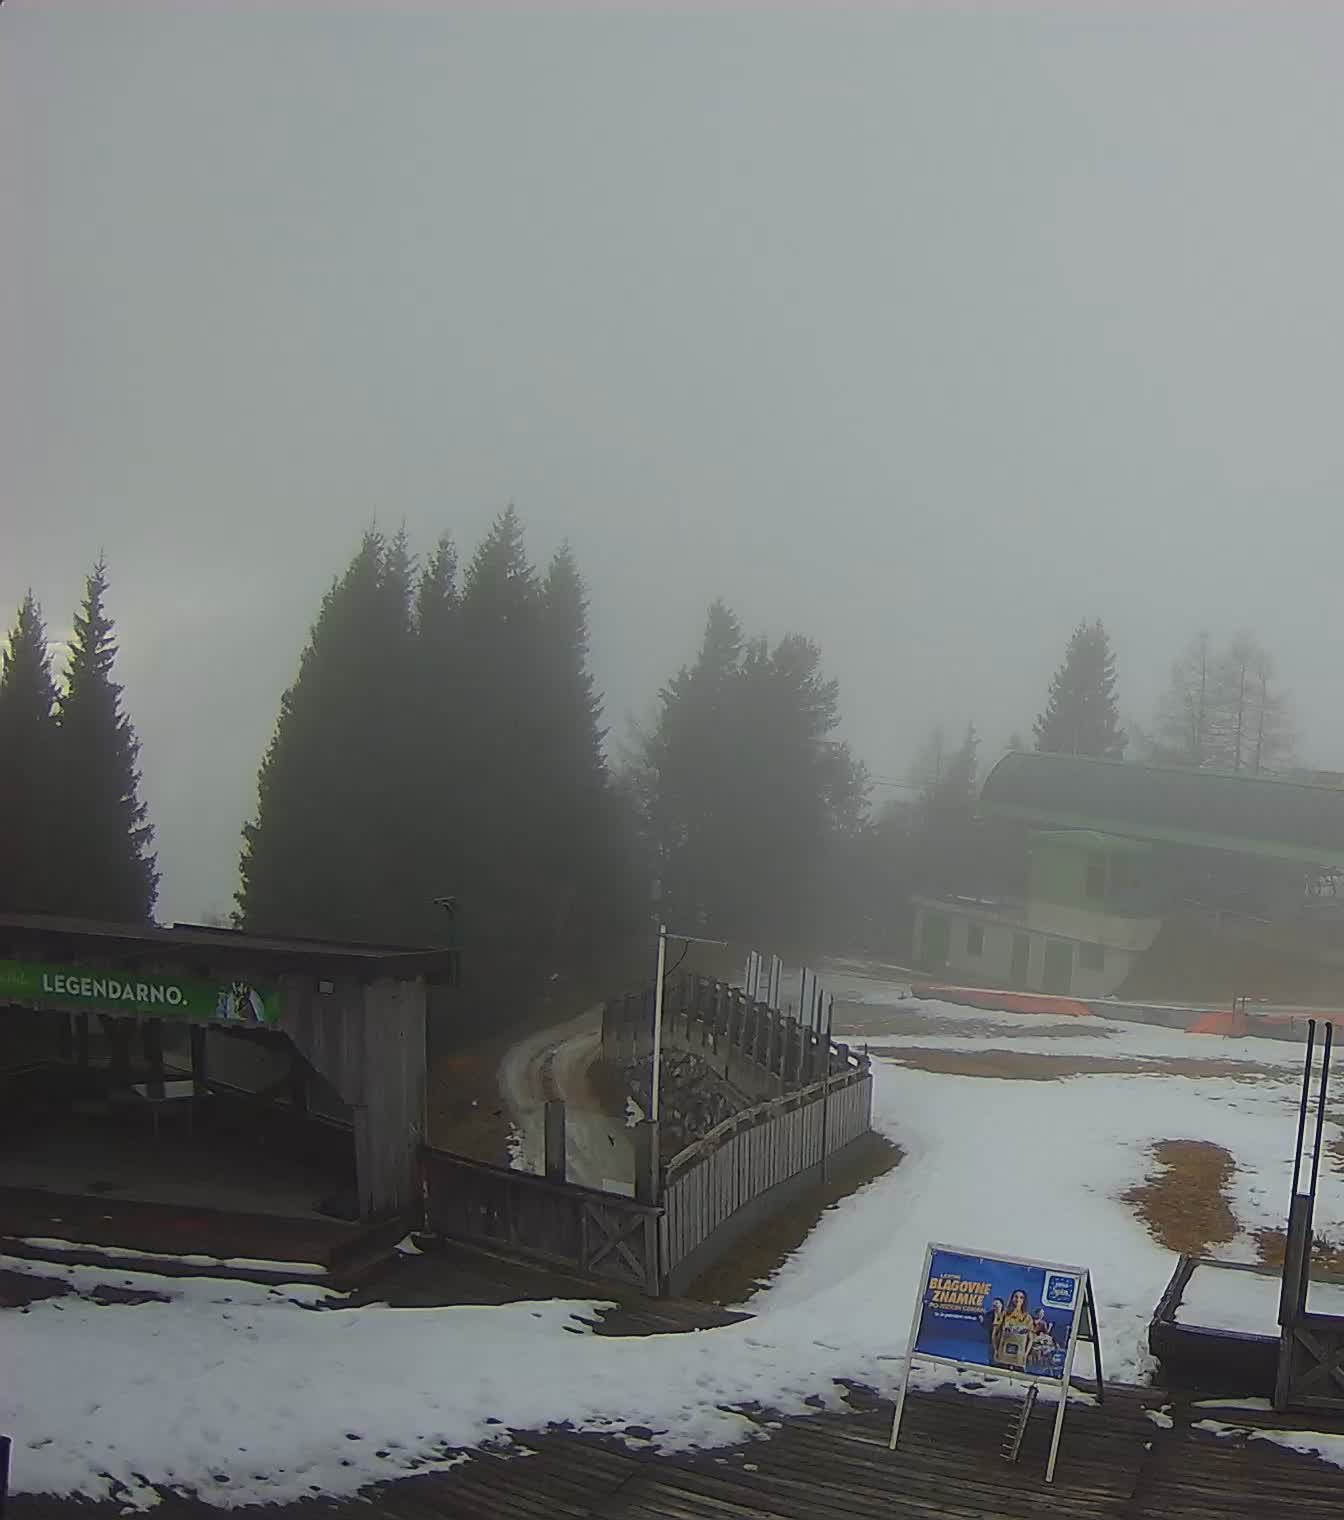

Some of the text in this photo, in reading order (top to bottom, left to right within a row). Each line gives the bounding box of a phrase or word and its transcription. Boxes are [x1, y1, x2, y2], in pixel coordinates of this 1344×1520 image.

[43, 973, 189, 1006] LEGENDARNO.
[928, 1277, 992, 1295] BLAGOVNE
[931, 1290, 985, 1306] ZNAMKE
